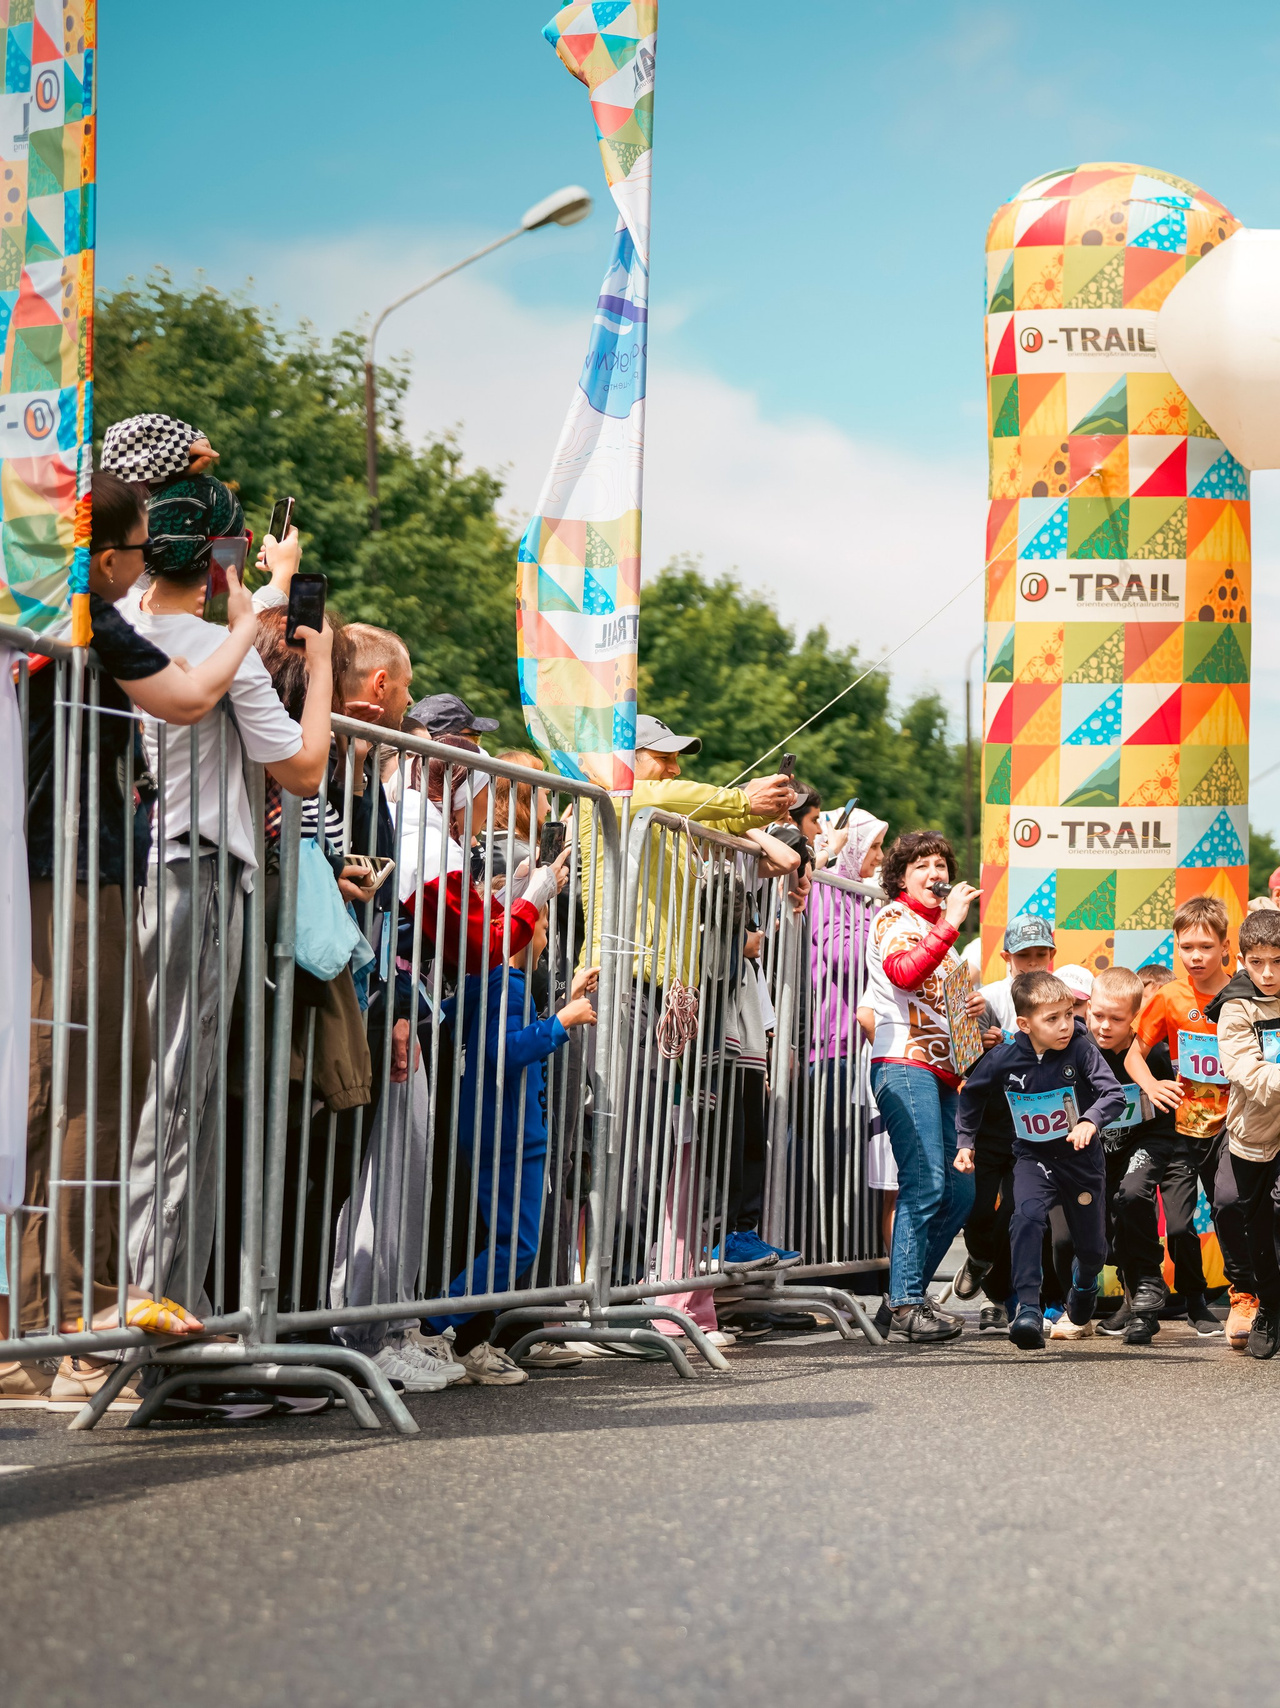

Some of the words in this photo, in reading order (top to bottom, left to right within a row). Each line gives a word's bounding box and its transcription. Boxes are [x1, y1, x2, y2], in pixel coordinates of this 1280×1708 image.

[1076, 600, 1180, 609] orienteering&trailrunning
[1068, 847, 1172, 857] orienteering&trailrunning
[1190, 1055, 1224, 1077] 10
[1020, 1109, 1069, 1135] 102
